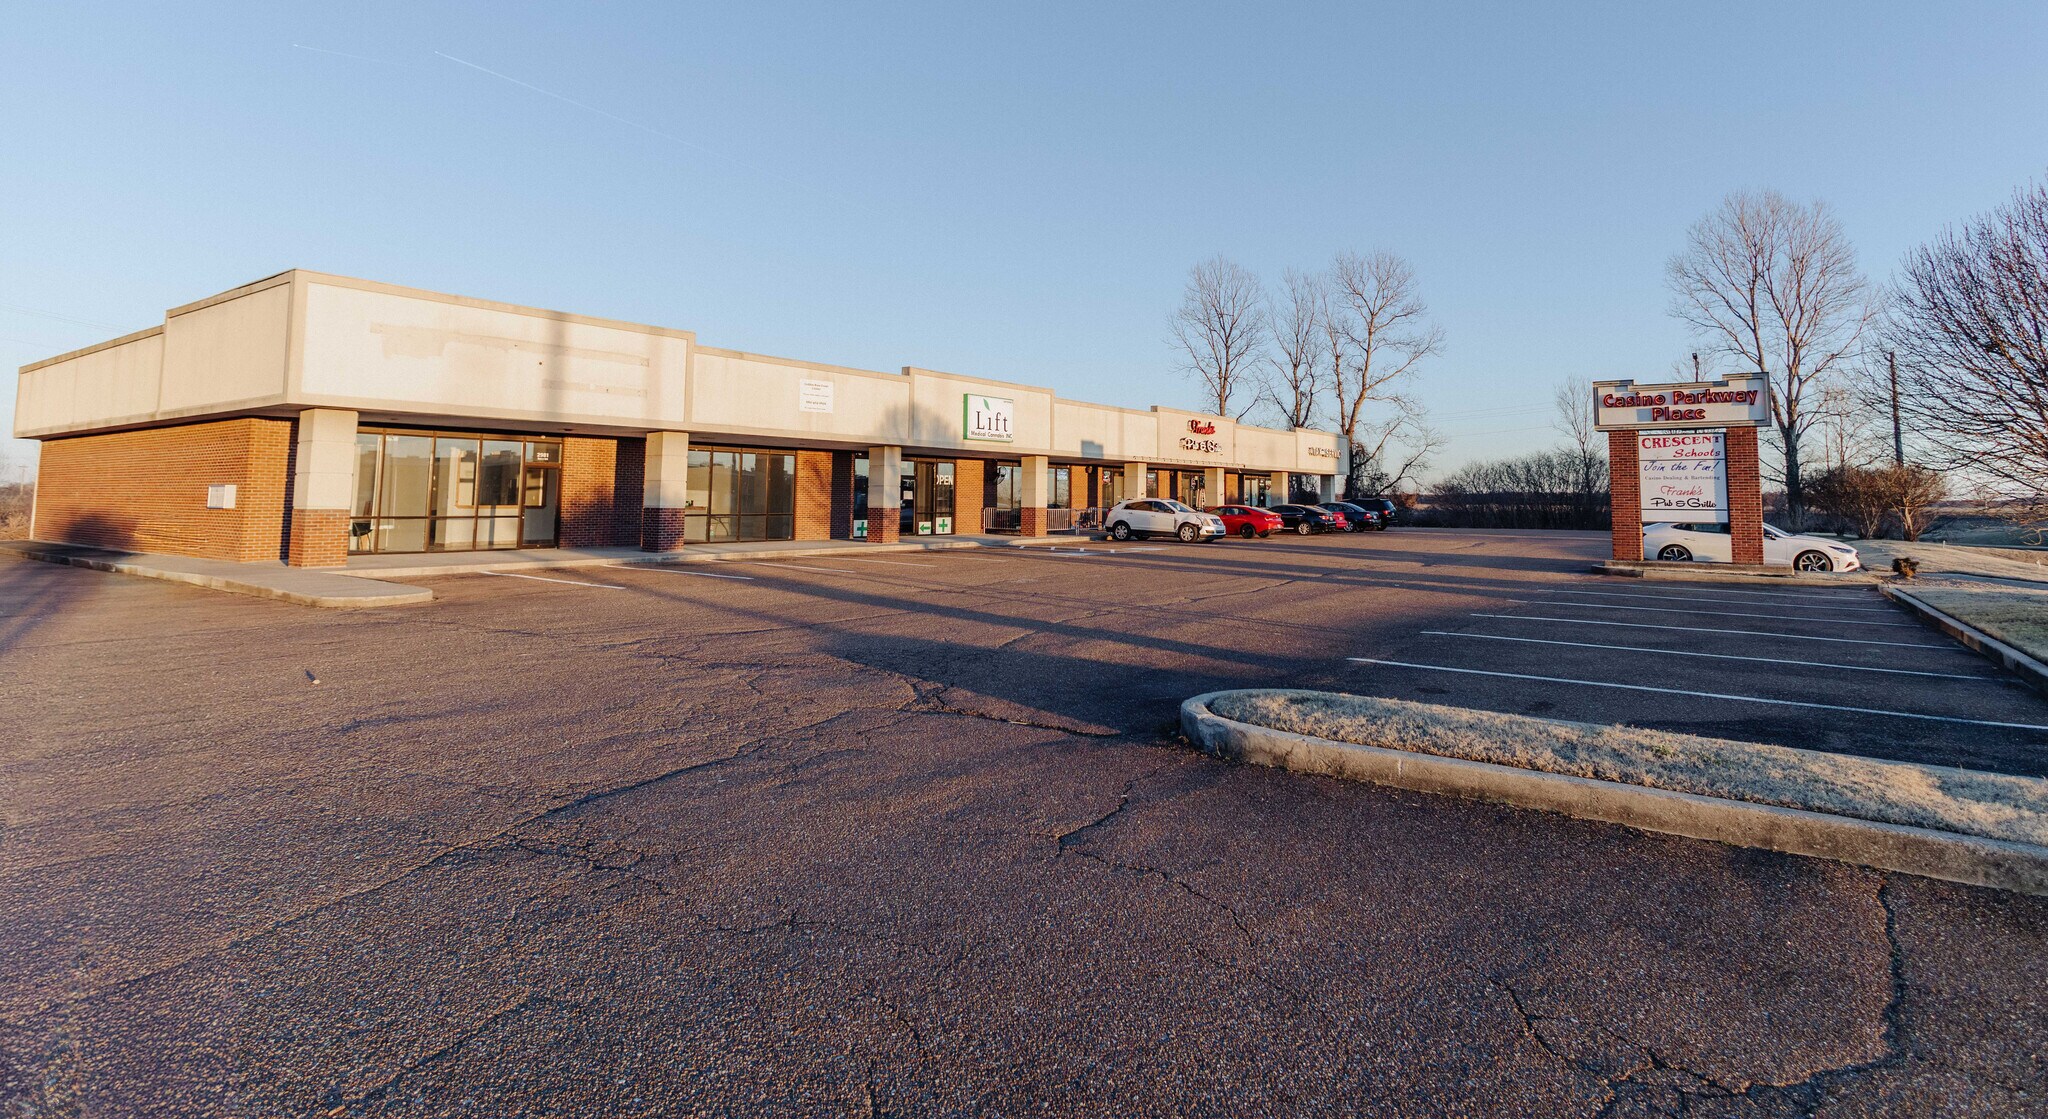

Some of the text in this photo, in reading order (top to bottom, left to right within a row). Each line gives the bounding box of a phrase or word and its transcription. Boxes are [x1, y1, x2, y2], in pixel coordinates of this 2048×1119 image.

[1603, 388, 1759, 408] Casino Parkway
[1651, 406, 1706, 422] Place
[976, 411, 1008, 432] Lift
[1641, 436, 1722, 449] CRESCENT
[1672, 448, 1721, 458] Schools
[1643, 460, 1720, 472] Join the Fun!
[1660, 485, 1704, 496] Frank's
[1649, 497, 1673, 507] Pub
